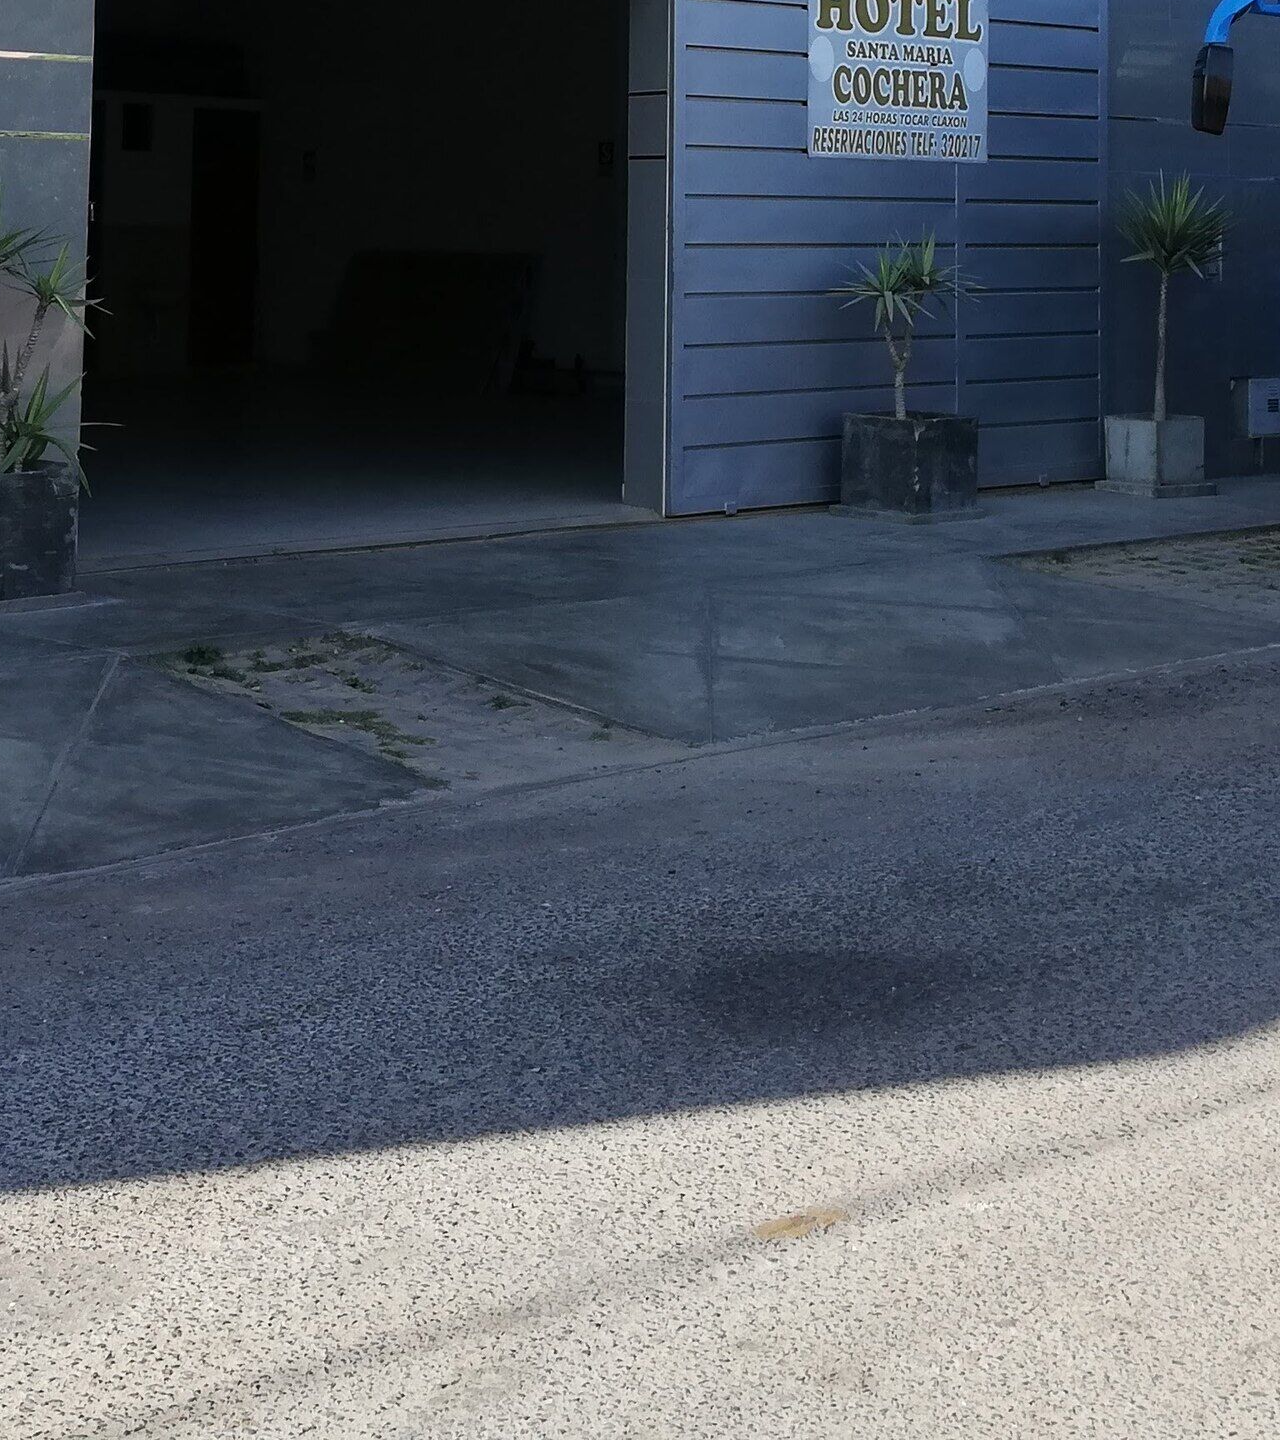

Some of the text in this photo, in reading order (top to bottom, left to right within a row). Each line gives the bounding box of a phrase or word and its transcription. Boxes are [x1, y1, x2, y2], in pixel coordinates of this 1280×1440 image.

[847, 40, 953, 66] SANTA MARIA
[833, 64, 968, 111] COCHERA
[832, 110, 968, 128] LAS 24 HORAS TOCAR CLAXON
[813, 126, 982, 159] RESERVACIONES TELF: 320217
